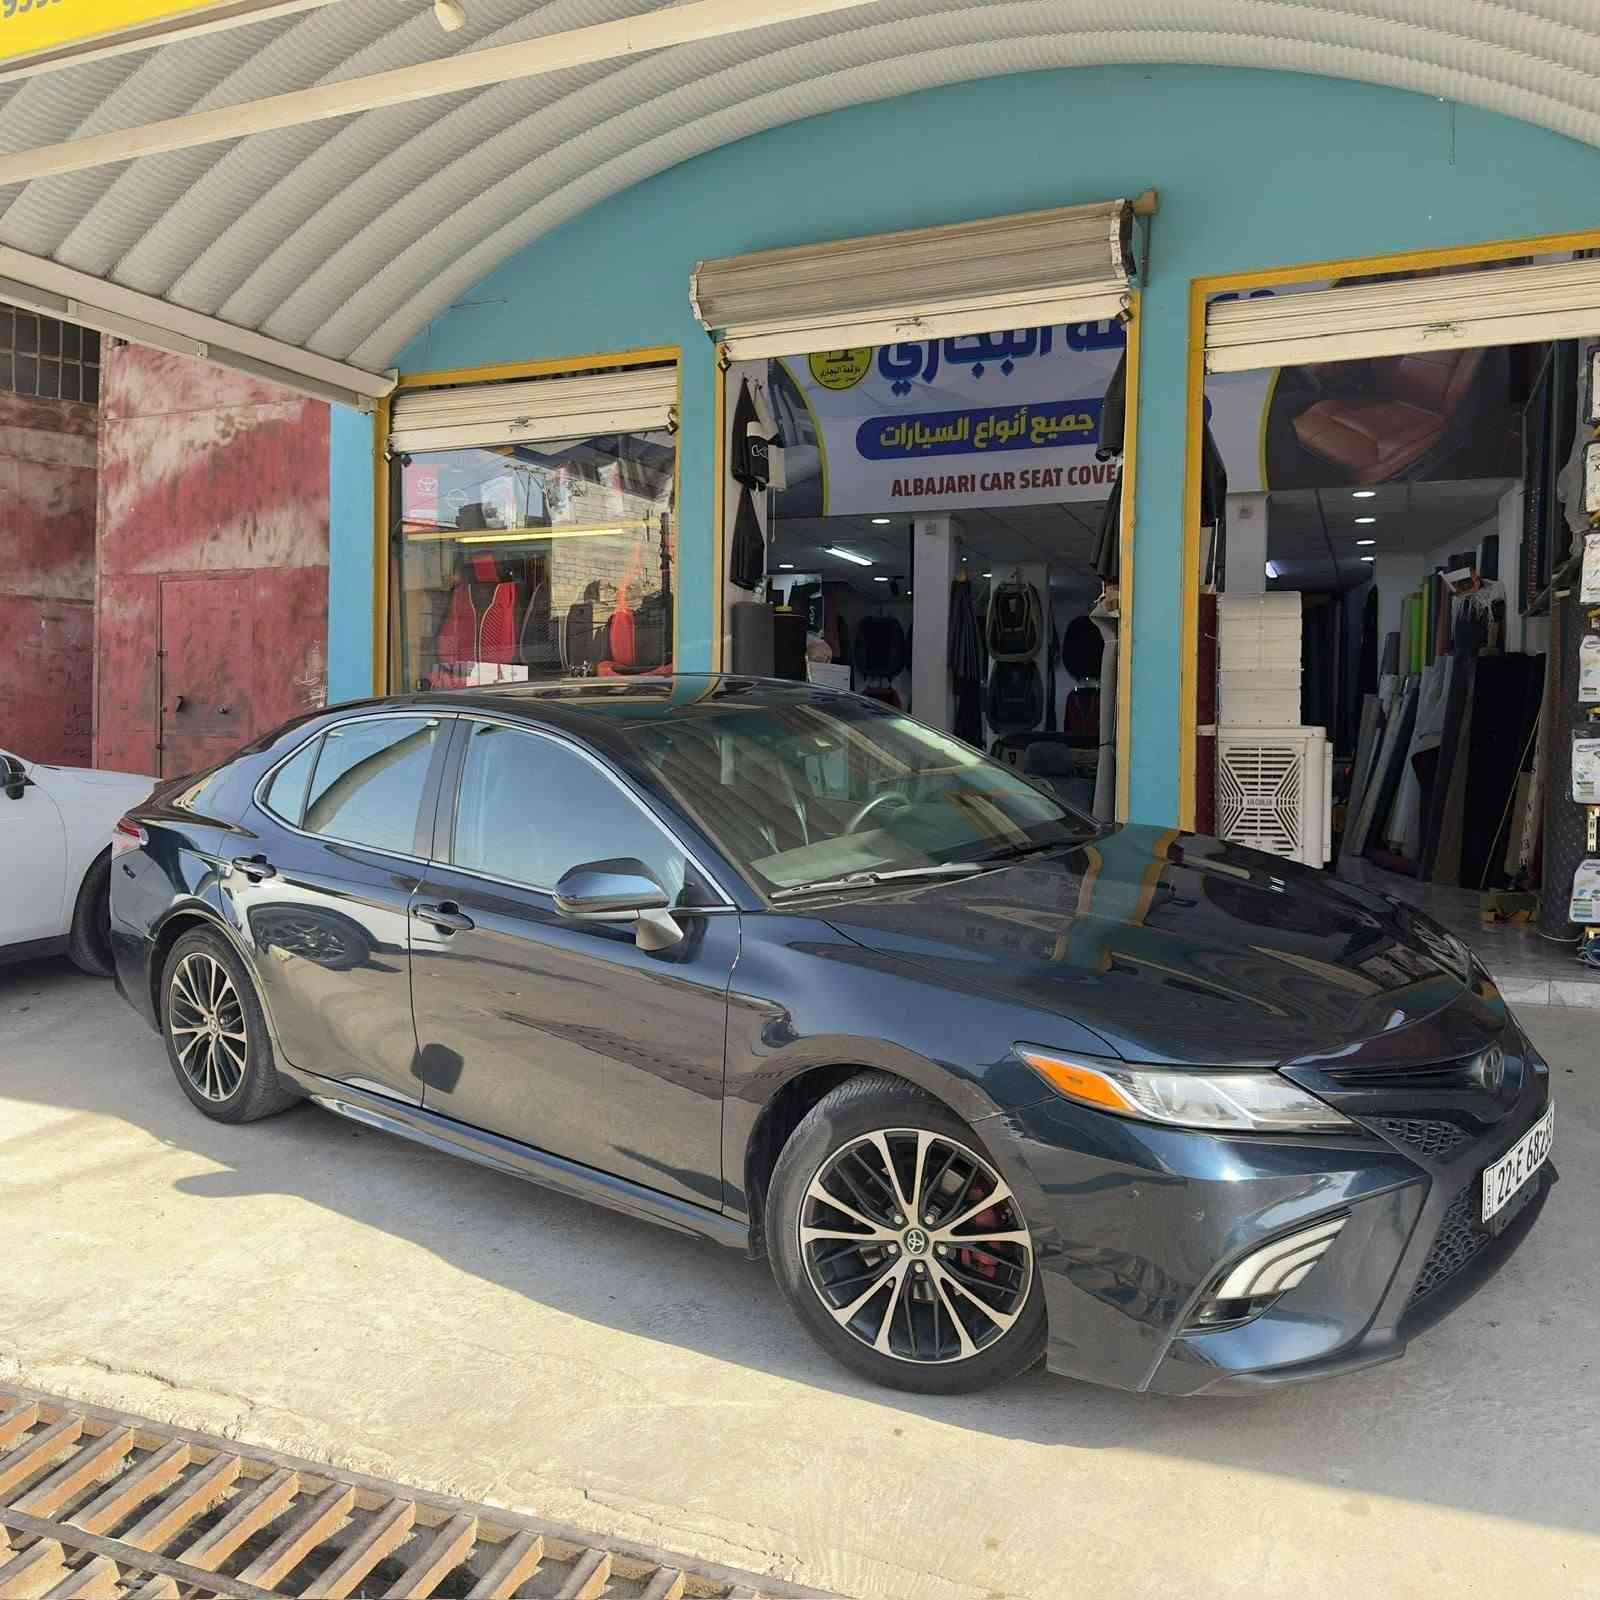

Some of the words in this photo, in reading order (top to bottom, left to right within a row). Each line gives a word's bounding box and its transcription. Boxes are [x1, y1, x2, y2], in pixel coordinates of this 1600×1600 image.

[879, 416, 969, 450] السيارات
[973, 407, 1027, 449] أنواع
[1030, 412, 1095, 443] جميع
[891, 474, 976, 497] ALBAJARI
[980, 470, 1016, 491] CAR
[1020, 467, 1063, 489] SEAT
[1067, 463, 1118, 486] COVE
